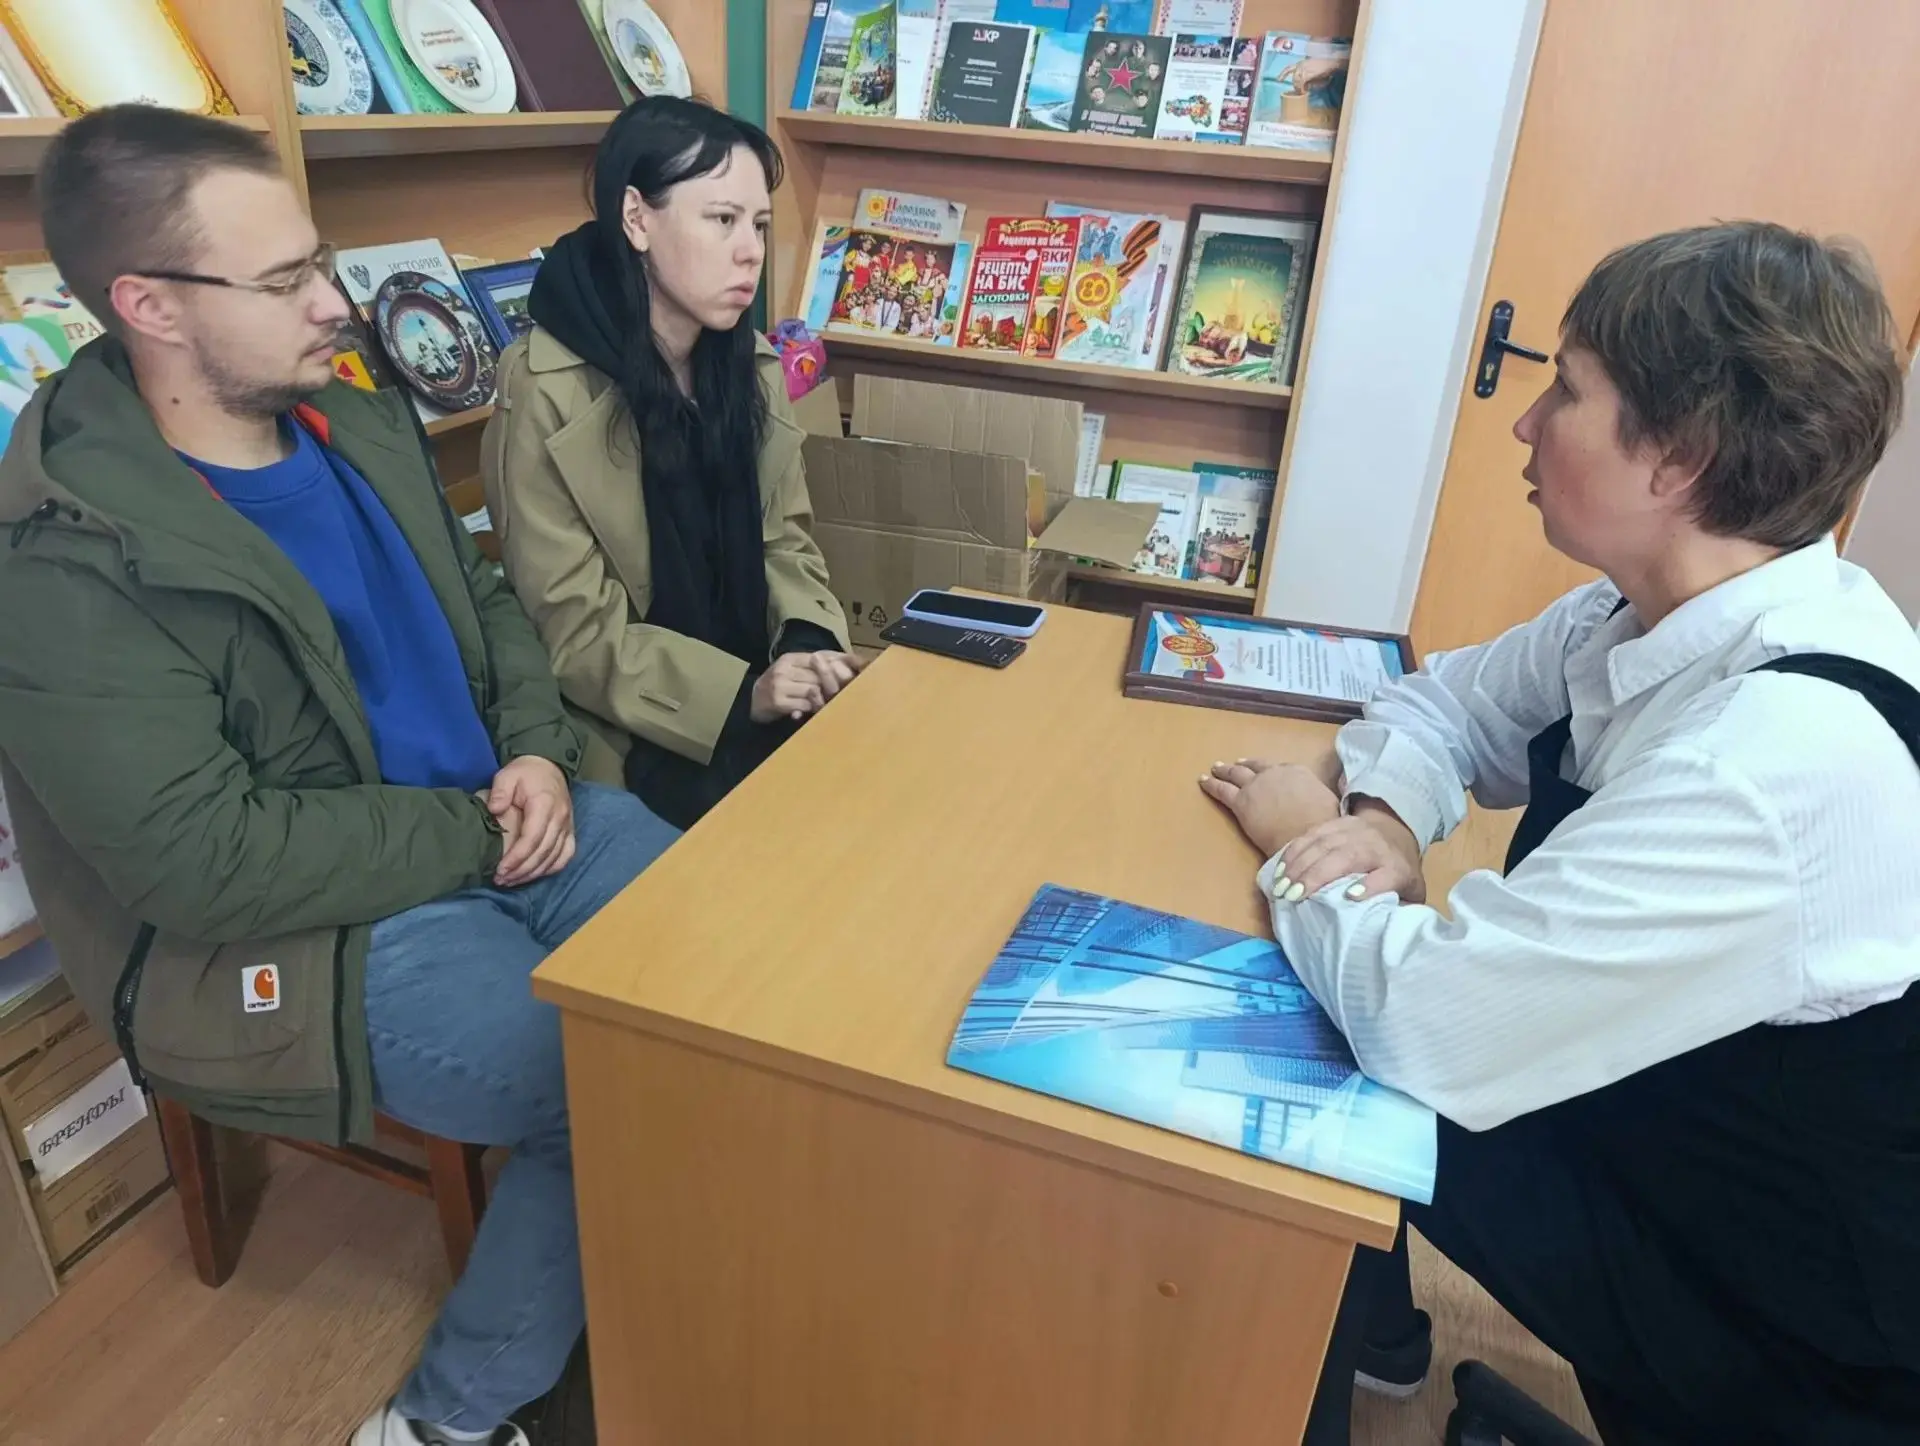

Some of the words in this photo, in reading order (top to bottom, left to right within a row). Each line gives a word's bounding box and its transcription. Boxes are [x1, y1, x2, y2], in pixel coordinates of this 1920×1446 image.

[388, 256, 442, 274] ИСТОРИЯ
[976, 261, 1032, 276] РЕЦЕПТЫ
[974, 275, 994, 290] НА
[998, 275, 1028, 291] БИС
[1079, 278, 1106, 302] 80
[972, 292, 1030, 304] ЗАГОТОВКИ
[38, 1086, 126, 1157] БРЕНДЫ
